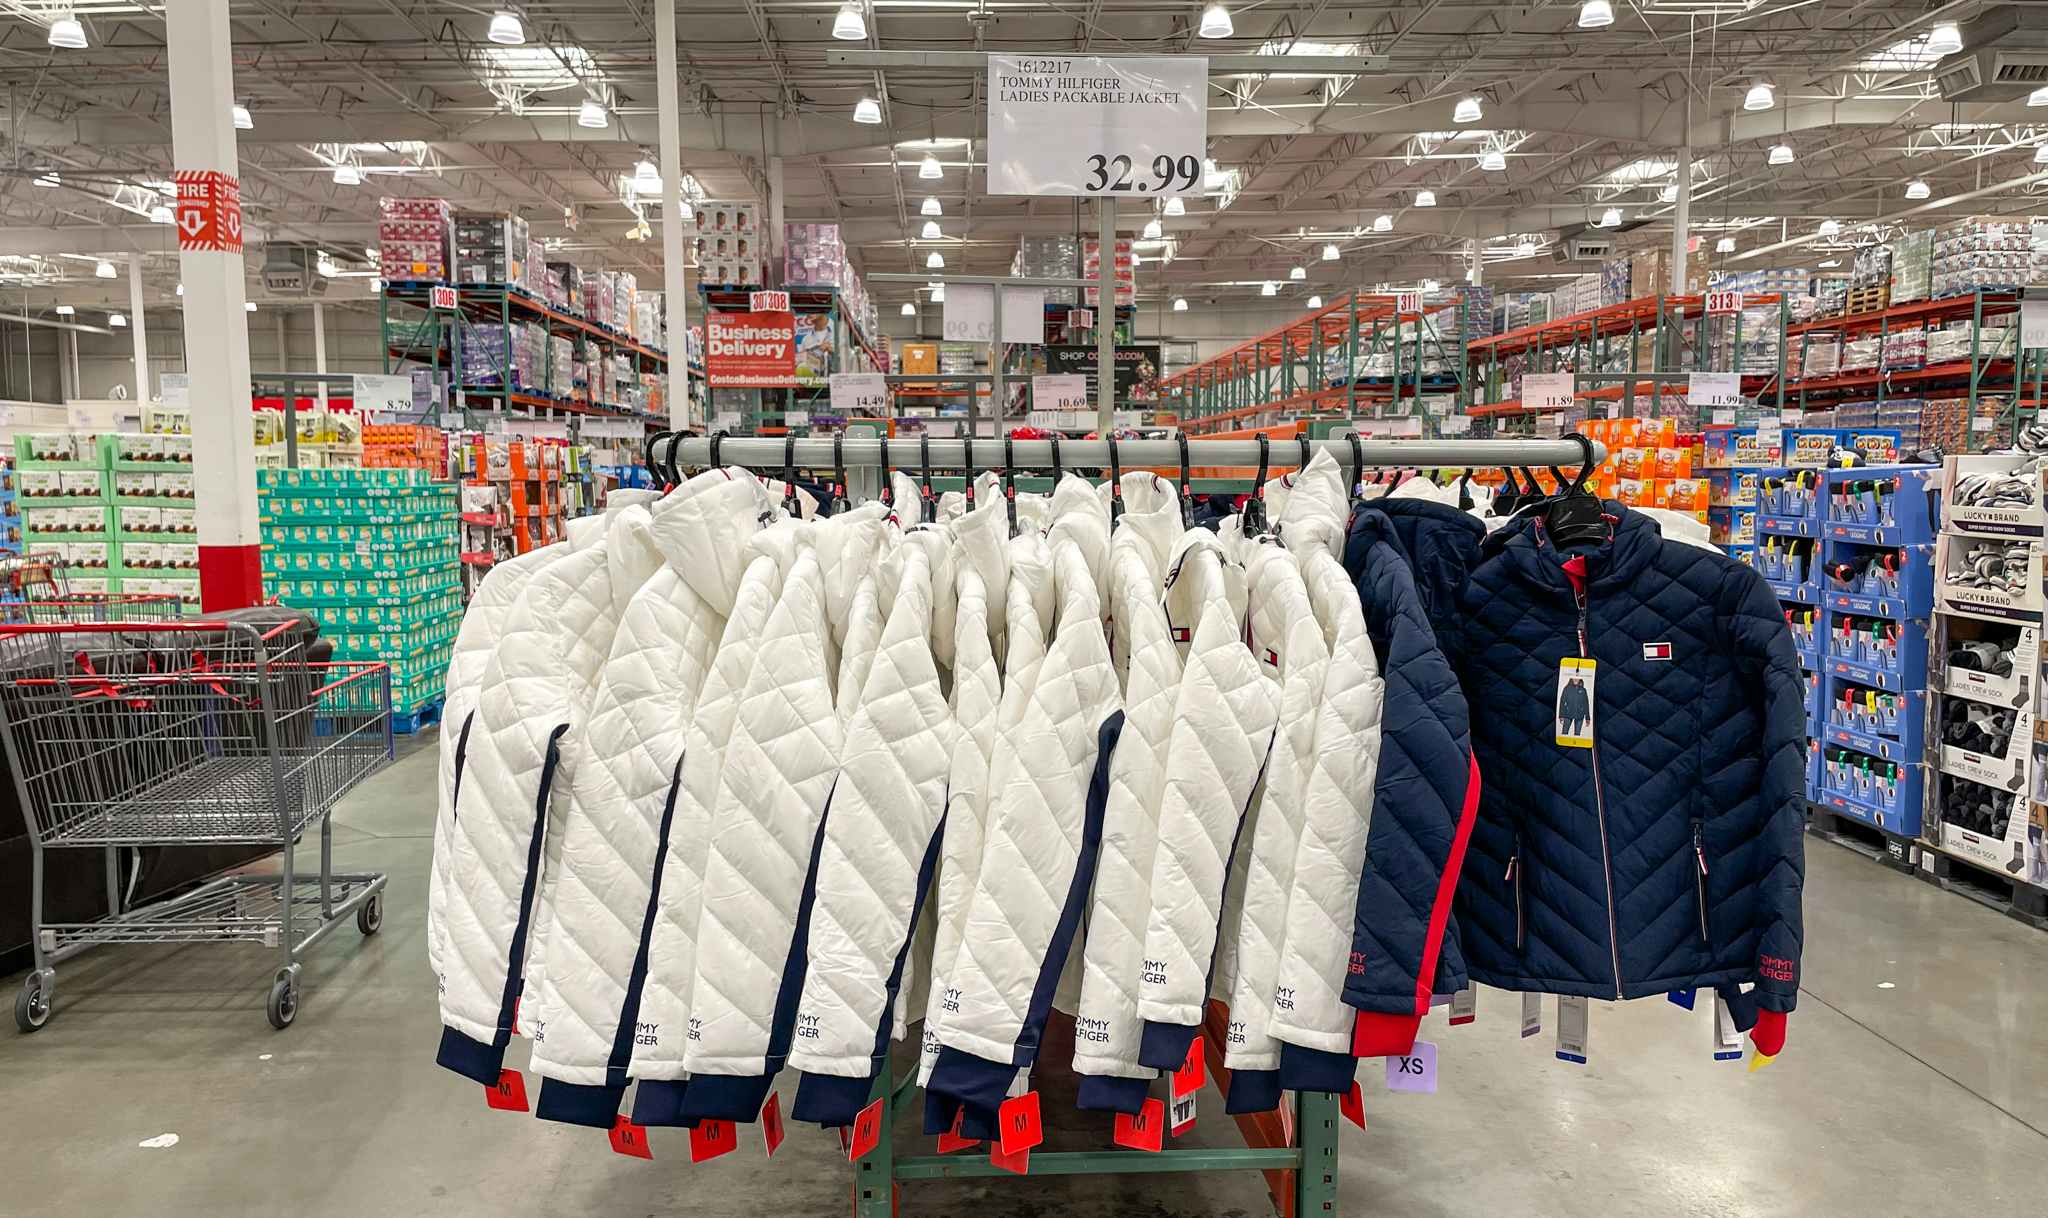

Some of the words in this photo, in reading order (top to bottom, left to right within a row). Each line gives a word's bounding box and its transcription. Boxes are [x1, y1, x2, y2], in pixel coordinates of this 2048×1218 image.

[1017, 60, 1071, 74] 1612217
[1000, 76, 1052, 89] TOMMY
[1057, 77, 1120, 89] HILFIGER
[1000, 90, 1049, 103] LADIES
[1053, 91, 1125, 104] PACKABLE
[1129, 92, 1181, 104] JACKET
[1085, 154, 1200, 192] 32.99
[177, 183, 209, 198] FIRE
[436, 288, 454, 306] 306
[1401, 294, 1416, 311] 311
[1710, 292, 1733, 310] 313
[708, 325, 793, 340] Business
[708, 341, 786, 359] Delivery
[1060, 351, 1085, 361] SHOP
[1087, 351, 1144, 361] COCO.COM
[387, 400, 412, 409] 8.79
[856, 396, 884, 406] 14.49
[1057, 398, 1085, 408] 10.69
[1545, 395, 1573, 406] 11.89
[1711, 395, 1738, 405] 11.99
[1963, 511, 1988, 520] LUCKY
[1994, 513, 2020, 522] BRAND
[1956, 591, 1979, 601] LUCKY
[1986, 595, 2011, 606] BRAND
[2025, 628, 2033, 641] 4
[2021, 713, 2028, 725] 4
[2019, 796, 2026, 808] 4
[1277, 985, 1295, 998] MY
[797, 1026, 819, 1039] GER
[635, 1034, 658, 1046] GER
[1184, 1057, 1195, 1077] M
[1398, 1056, 1424, 1076] XS
[498, 1083, 512, 1098] M
[862, 1119, 872, 1138] M
[1014, 1112, 1028, 1132] M
[1132, 1114, 1146, 1132] M
[621, 1130, 635, 1146] M
[706, 1123, 720, 1141] M
